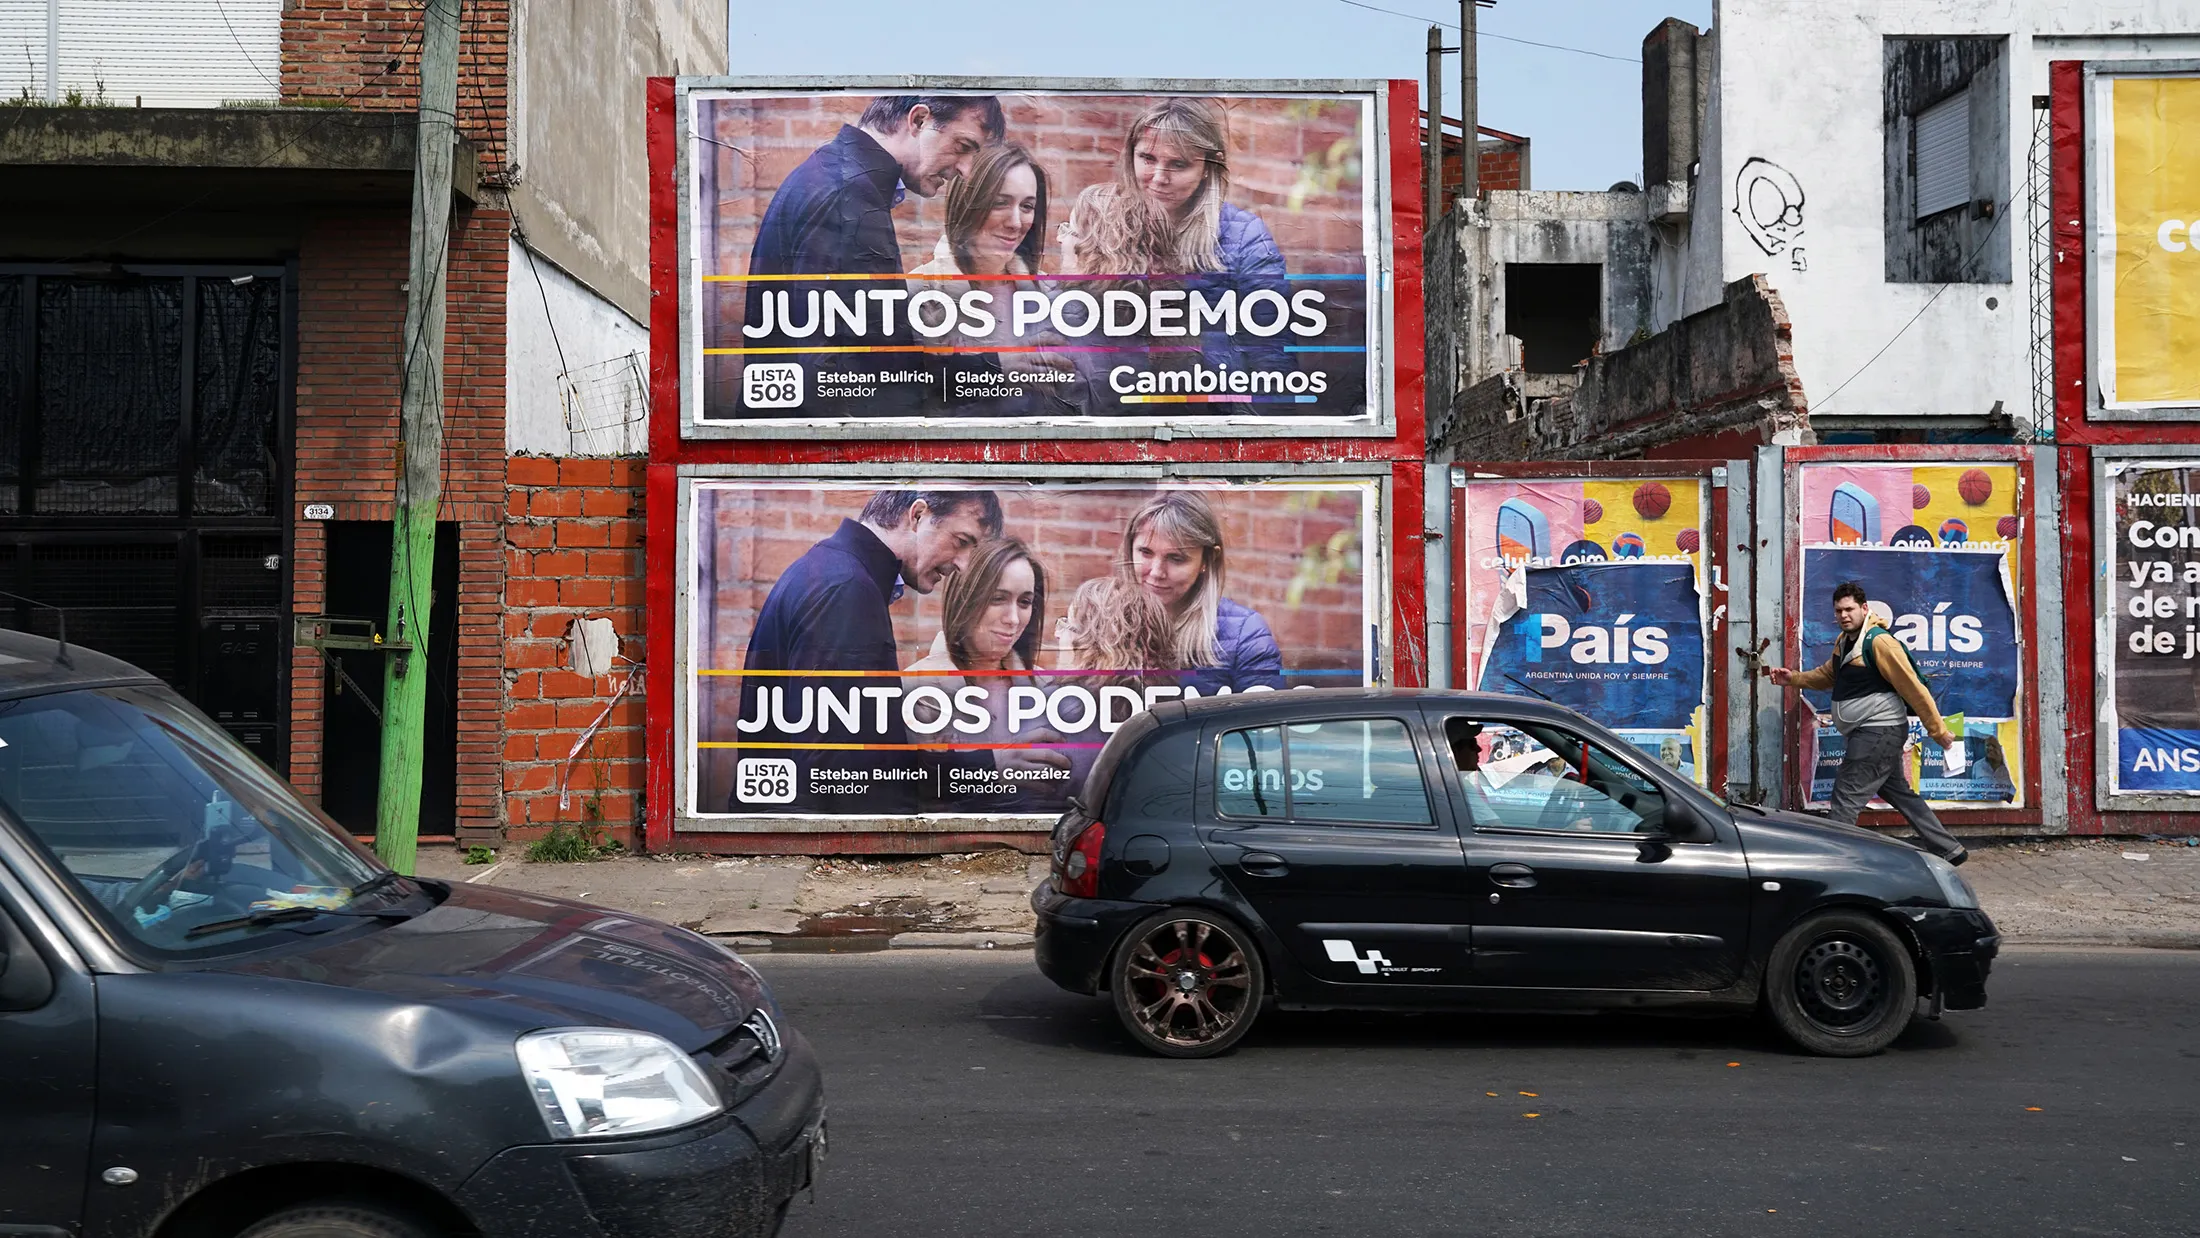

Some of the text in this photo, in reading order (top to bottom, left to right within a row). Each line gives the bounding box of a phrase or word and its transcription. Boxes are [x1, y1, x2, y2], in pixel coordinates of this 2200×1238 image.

[742, 289, 1327, 338] JUNTOS PODEMOS
[751, 370, 796, 381] LISTA
[817, 371, 934, 384] Esteban Bullrich
[955, 371, 1075, 384] Gladys González
[1109, 363, 1327, 394] Cambiemos
[750, 384, 796, 401] 508
[817, 385, 876, 397] Senador
[955, 385, 1023, 397] Senadora
[2128, 561, 2173, 588] ya
[2128, 590, 2177, 618] de
[1867, 601, 1983, 653] País
[2128, 625, 2176, 653] de
[1949, 660, 1984, 668] SIEMPRE
[1525, 671, 1669, 680] ARGENTINA UNIDA HOY Y SIEMPRE
[737, 685, 991, 734] JUNTOS
[745, 764, 789, 777] LISTA
[810, 768, 928, 780] Esteban Bullrich
[949, 767, 1070, 783] Gladys González
[743, 779, 789, 797] 508
[810, 782, 869, 794] Senador
[950, 782, 1017, 794] Senadora
